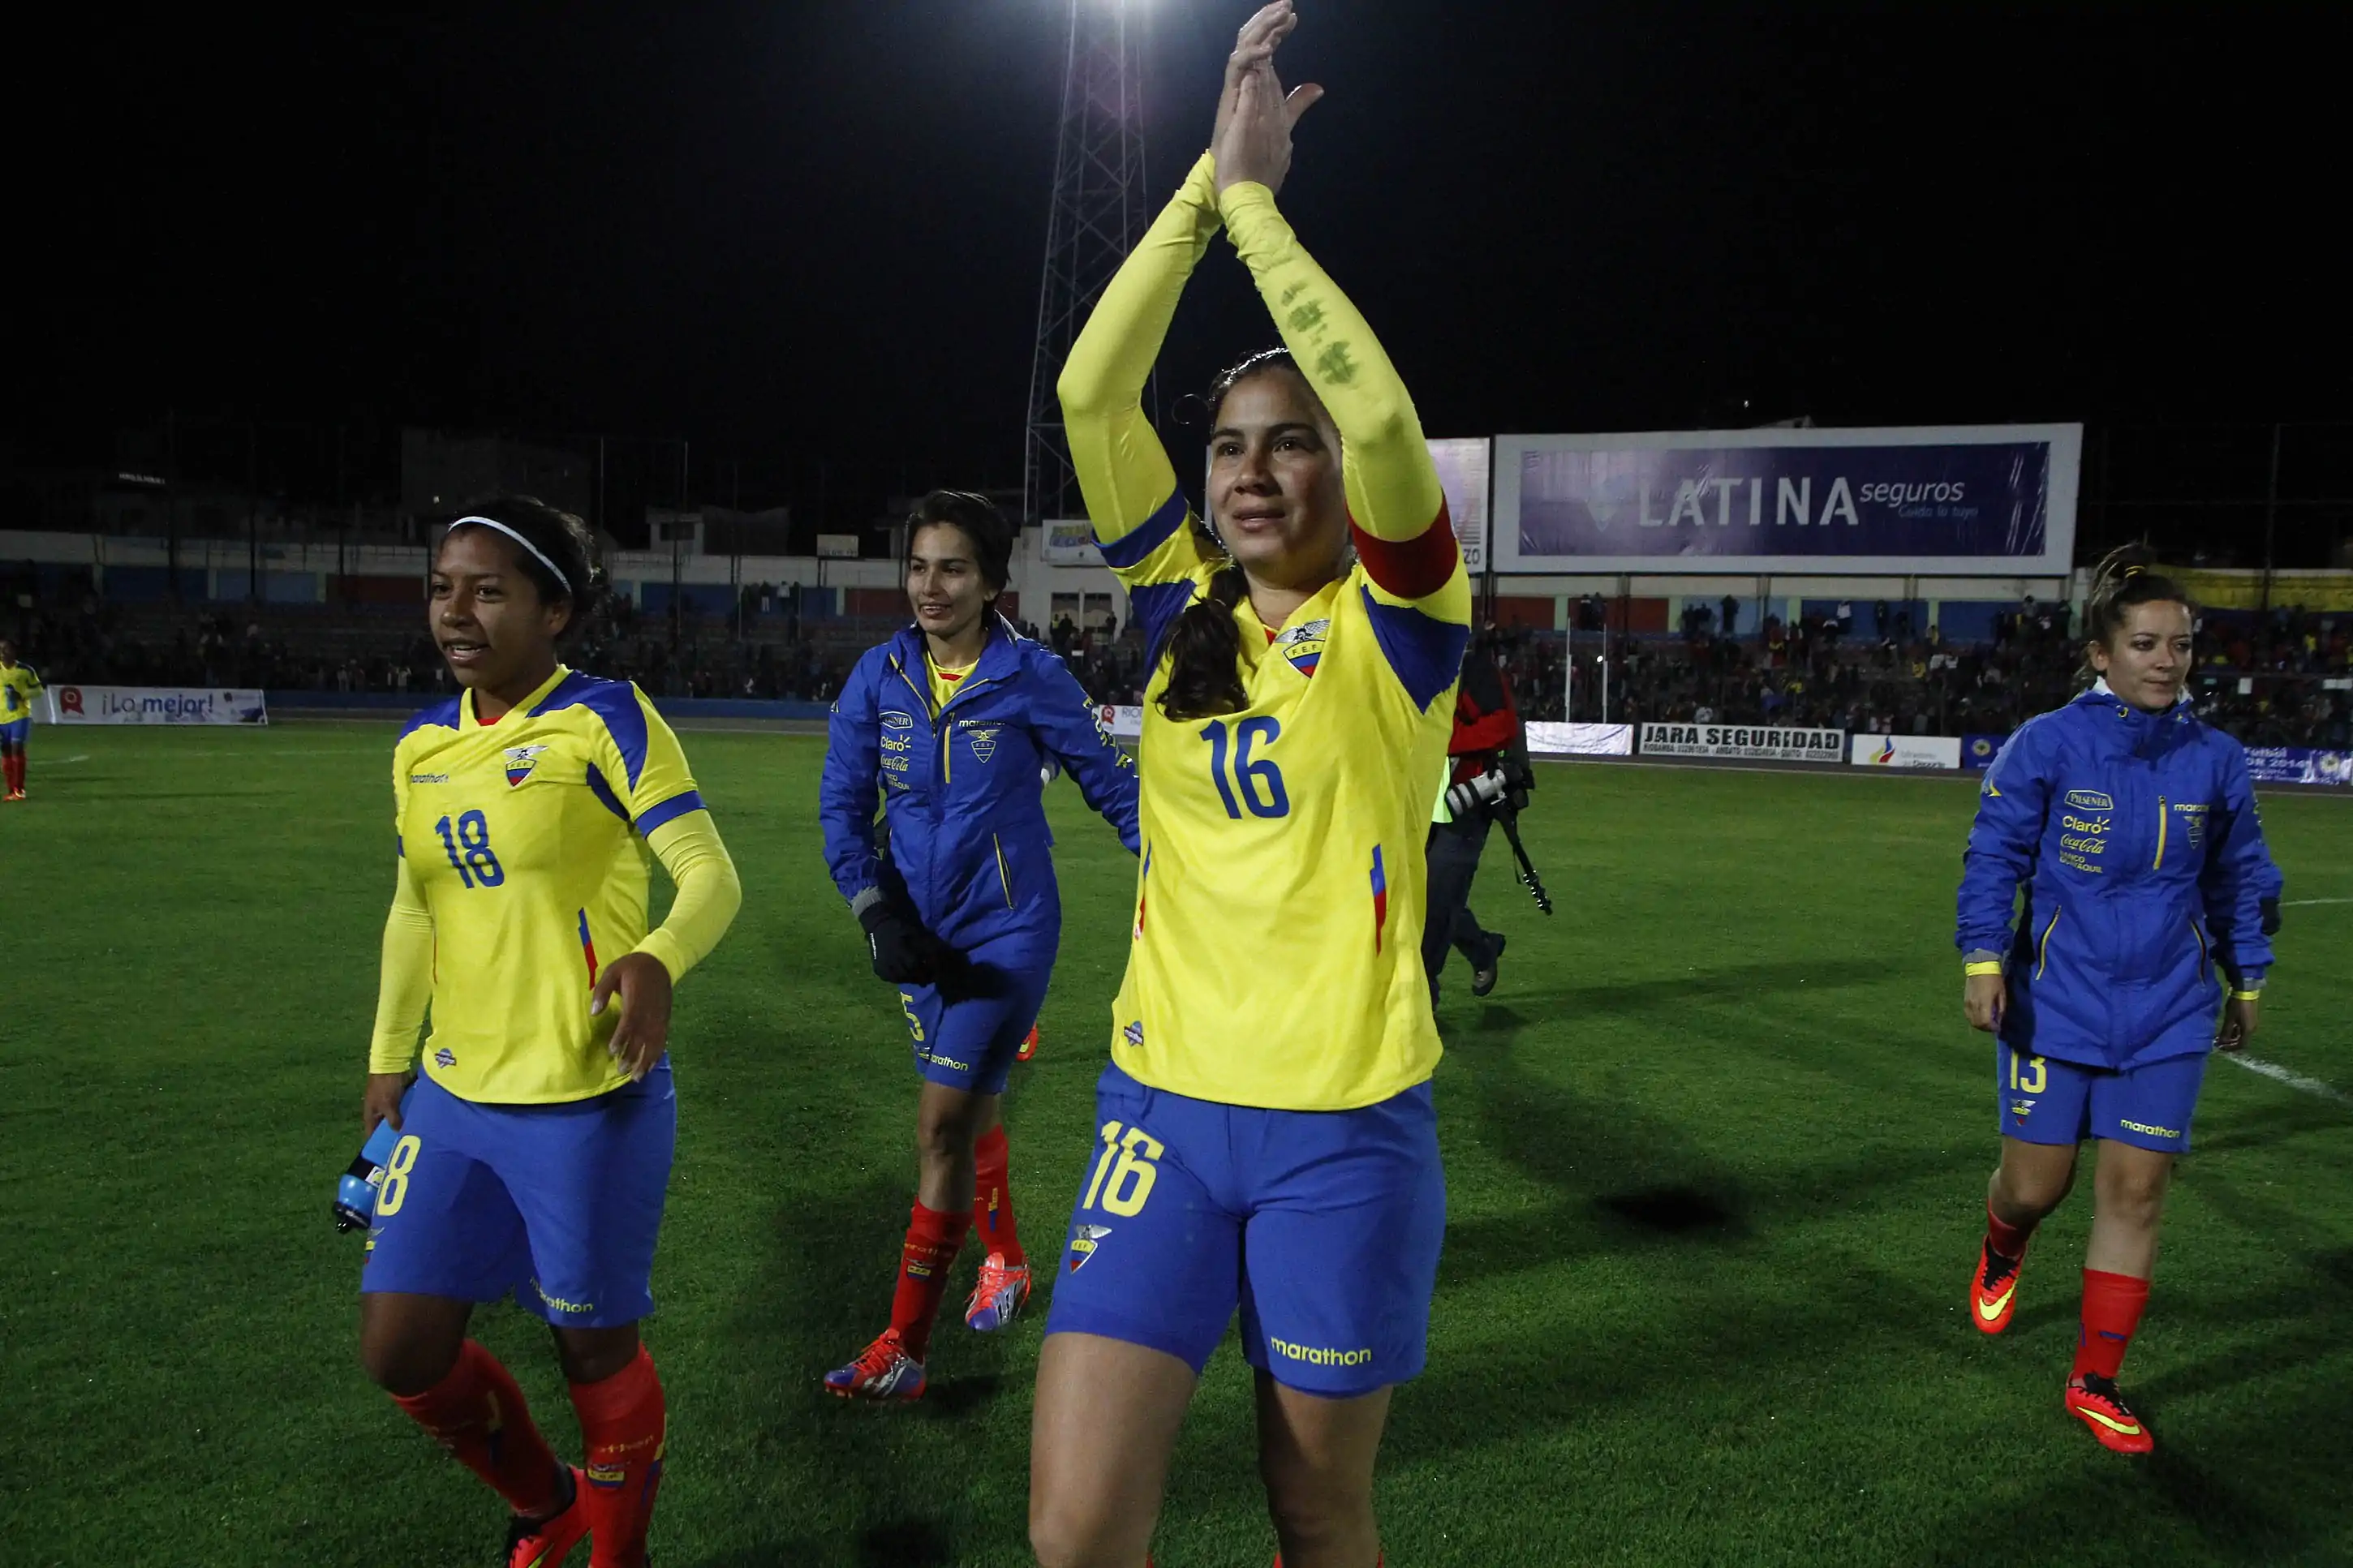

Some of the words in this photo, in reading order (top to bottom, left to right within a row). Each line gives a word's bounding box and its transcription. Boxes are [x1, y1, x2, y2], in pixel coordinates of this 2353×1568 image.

[1639, 476, 1859, 526] LATINA
[1860, 482, 1964, 508] seguros
[1898, 505, 1934, 518] Cuida
[1952, 505, 1978, 520] tuyo
[142, 694, 213, 717] mejor!
[880, 736, 905, 752] Claro
[1644, 726, 1699, 744] JARA
[1706, 728, 1840, 750] SEGURIDAD
[1198, 715, 1290, 819] 16
[2070, 793, 2109, 808] PILSENER
[2063, 815, 2103, 834] Claro
[435, 809, 505, 889] 18
[2011, 1049, 2047, 1093] 13
[2120, 1119, 2181, 1139] marathon
[1082, 1119, 1165, 1217] 16
[1271, 1336, 1371, 1366] marathon
